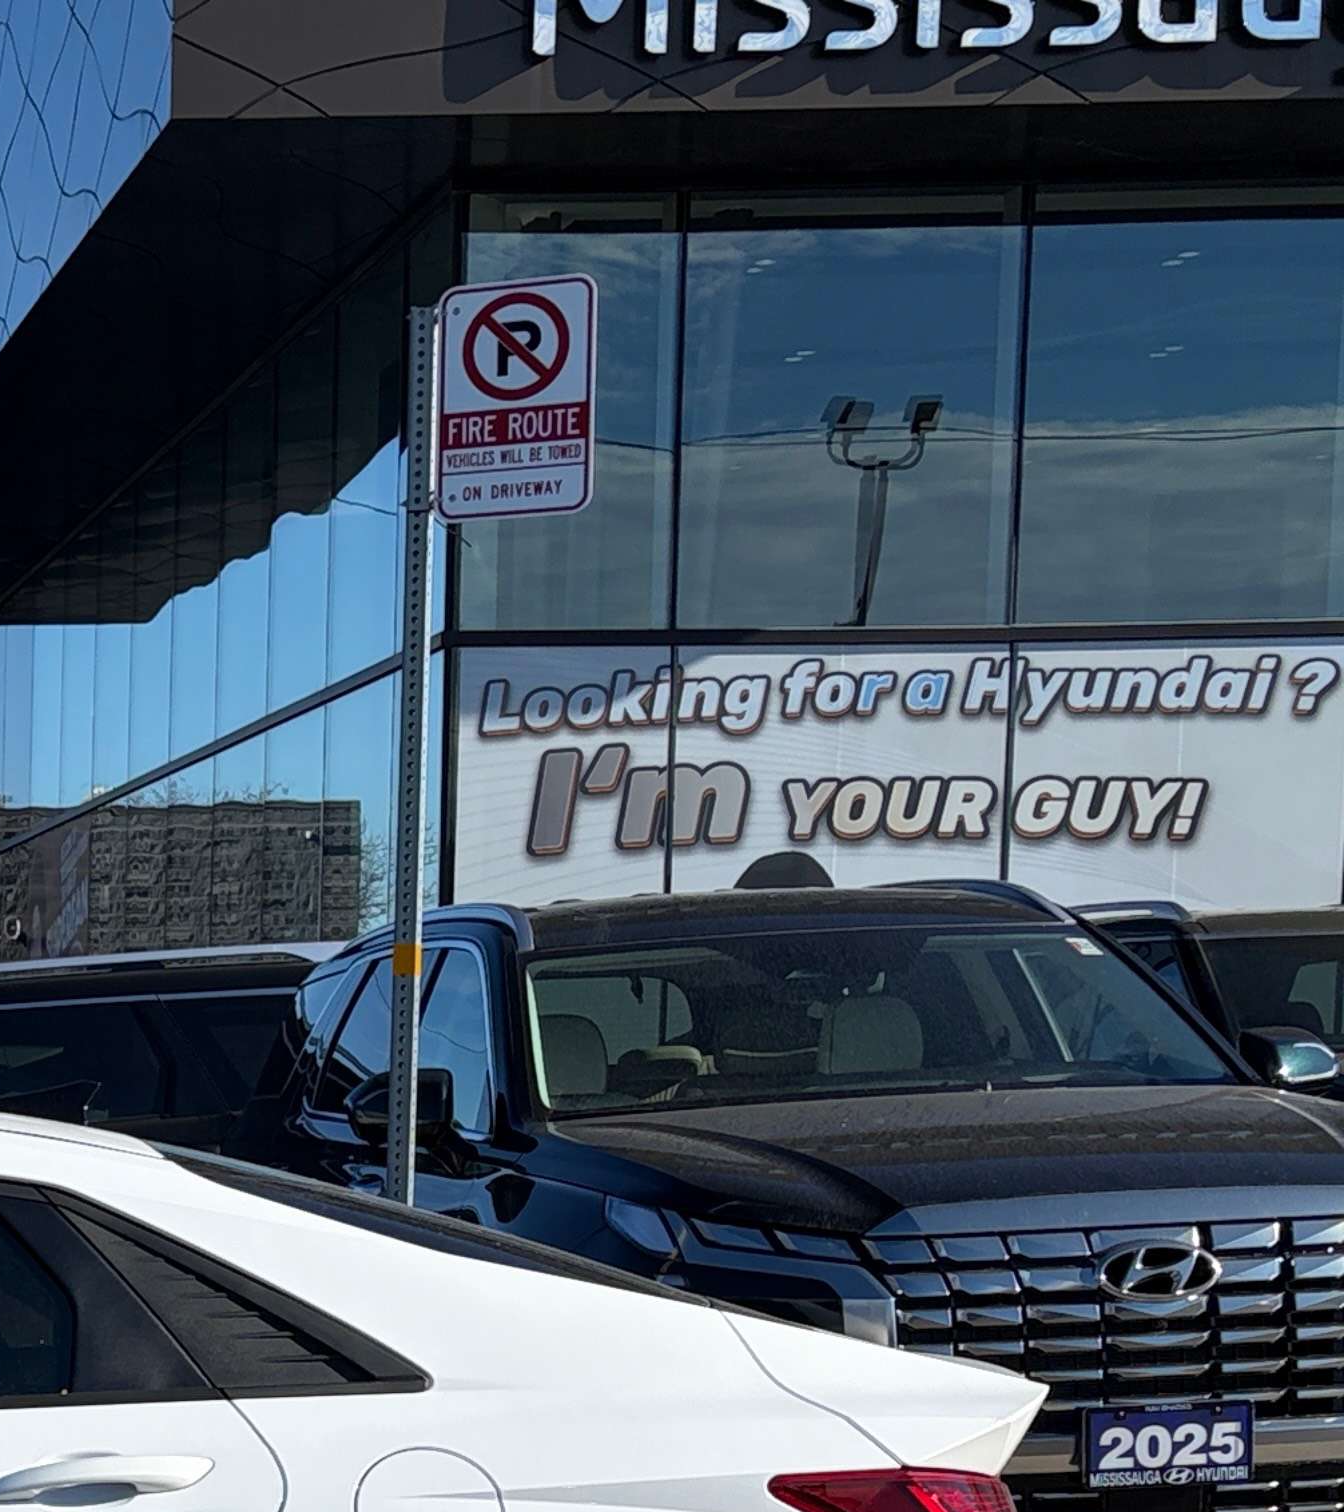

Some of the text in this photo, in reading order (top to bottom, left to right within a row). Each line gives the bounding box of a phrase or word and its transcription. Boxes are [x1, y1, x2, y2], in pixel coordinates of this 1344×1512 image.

[447, 406, 581, 446] FIRE ROUTE
[445, 443, 582, 469] VEHICLES WILL BE TOWED
[462, 479, 563, 502] ON DRIVEWAY
[479, 664, 771, 738] Looking
[781, 658, 897, 719] for
[903, 669, 954, 716] a
[961, 654, 1282, 727] Hyundai
[526, 742, 1210, 857] I'm YOUR GUY!
[1098, 1421, 1245, 1470] 2025
[1089, 1465, 1249, 1488] MISSISSAUGA HYUNDAI
